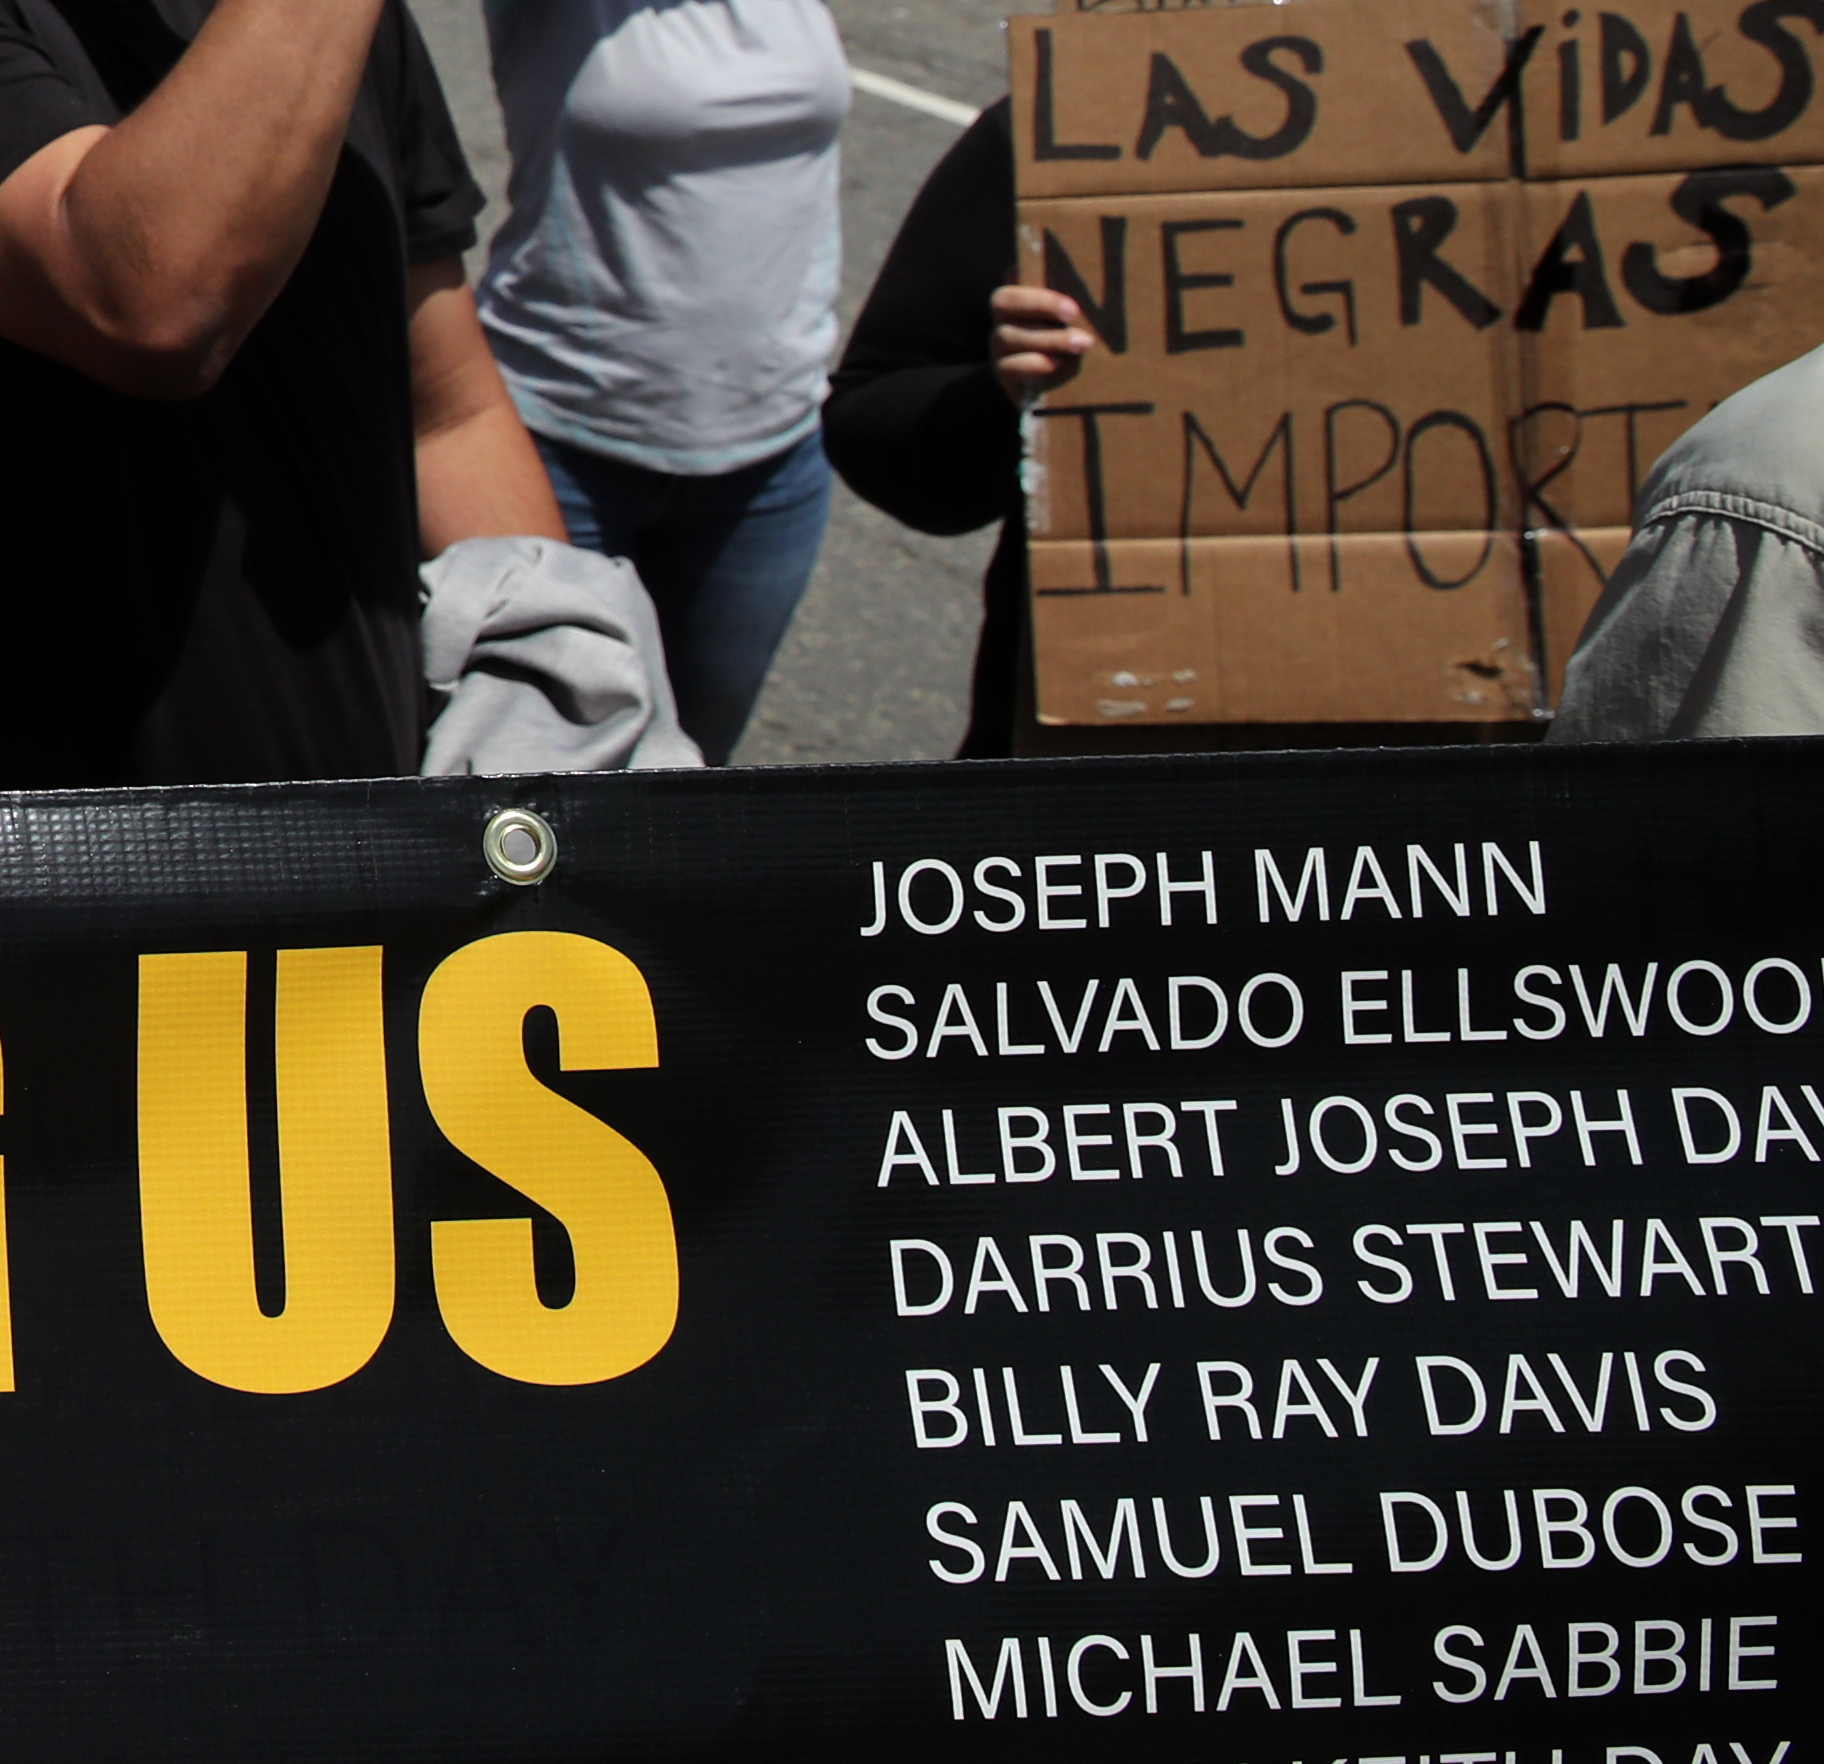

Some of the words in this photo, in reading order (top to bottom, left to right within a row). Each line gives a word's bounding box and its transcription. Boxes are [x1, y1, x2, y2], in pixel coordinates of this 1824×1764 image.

[1031, 28, 1324, 163] LAS
[1042, 164, 1798, 356] NEGRAS
[1033, 398, 1690, 598] IMPORT
[861, 851, 1217, 936] JOSEPH
[1255, 841, 1545, 922] MANN
[866, 973, 1303, 1059] SALVADO
[1342, 958, 1811, 1044] ELLSWOO
[137, 931, 679, 1394] US
[878, 1100, 1237, 1187] ALBERT
[1275, 1090, 1643, 1175] JOSEPH
[890, 1227, 1323, 1316] DARRIUS
[1353, 1216, 1820, 1303] STEWART
[906, 1363, 1160, 1448] BILLY
[1197, 1358, 1379, 1440] RAY
[1416, 1350, 1716, 1435] DAVIS
[927, 1494, 1352, 1583] SAMUEL
[1380, 1485, 1802, 1572] DUBOSE
[945, 1629, 1401, 1720] MICHAEL
[1433, 1616, 1777, 1703] SABBIE
